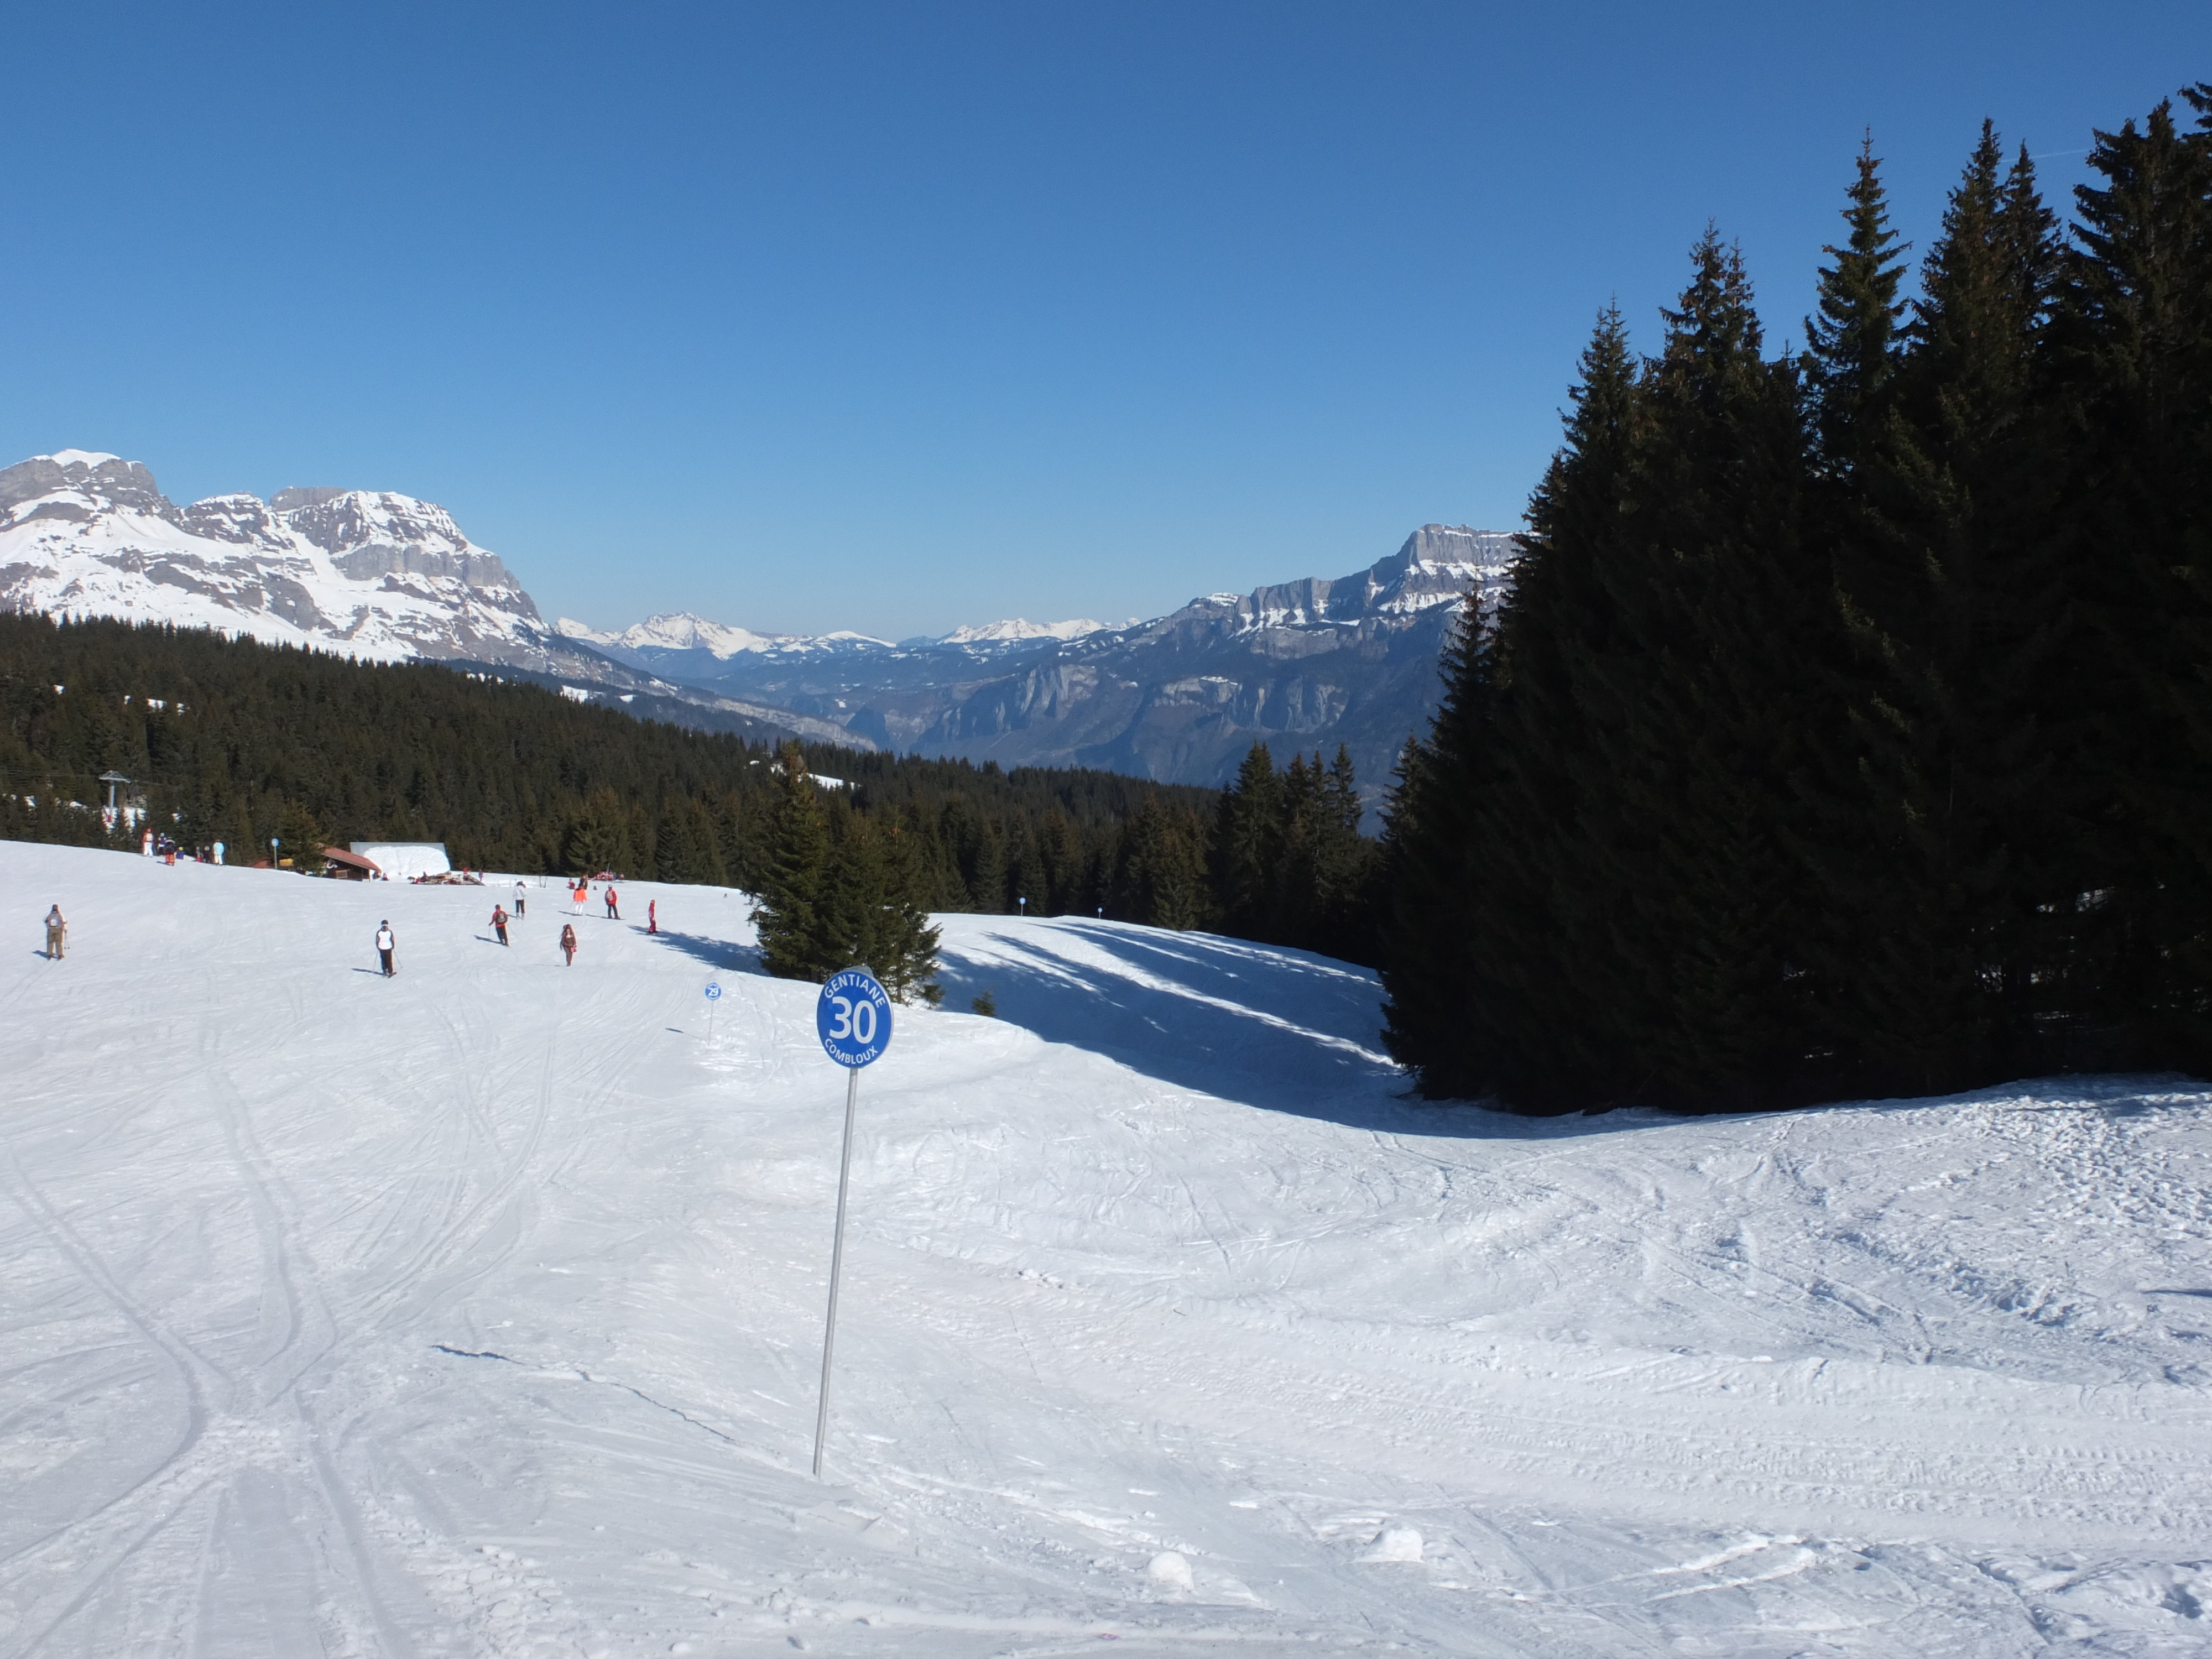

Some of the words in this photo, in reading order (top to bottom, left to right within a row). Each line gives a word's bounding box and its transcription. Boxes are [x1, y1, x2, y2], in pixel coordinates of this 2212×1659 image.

[708, 987, 719, 996] 29
[825, 974, 886, 1008] GENTIANE
[830, 996, 877, 1044] 30
[825, 1039, 878, 1065] COMBLOUX
